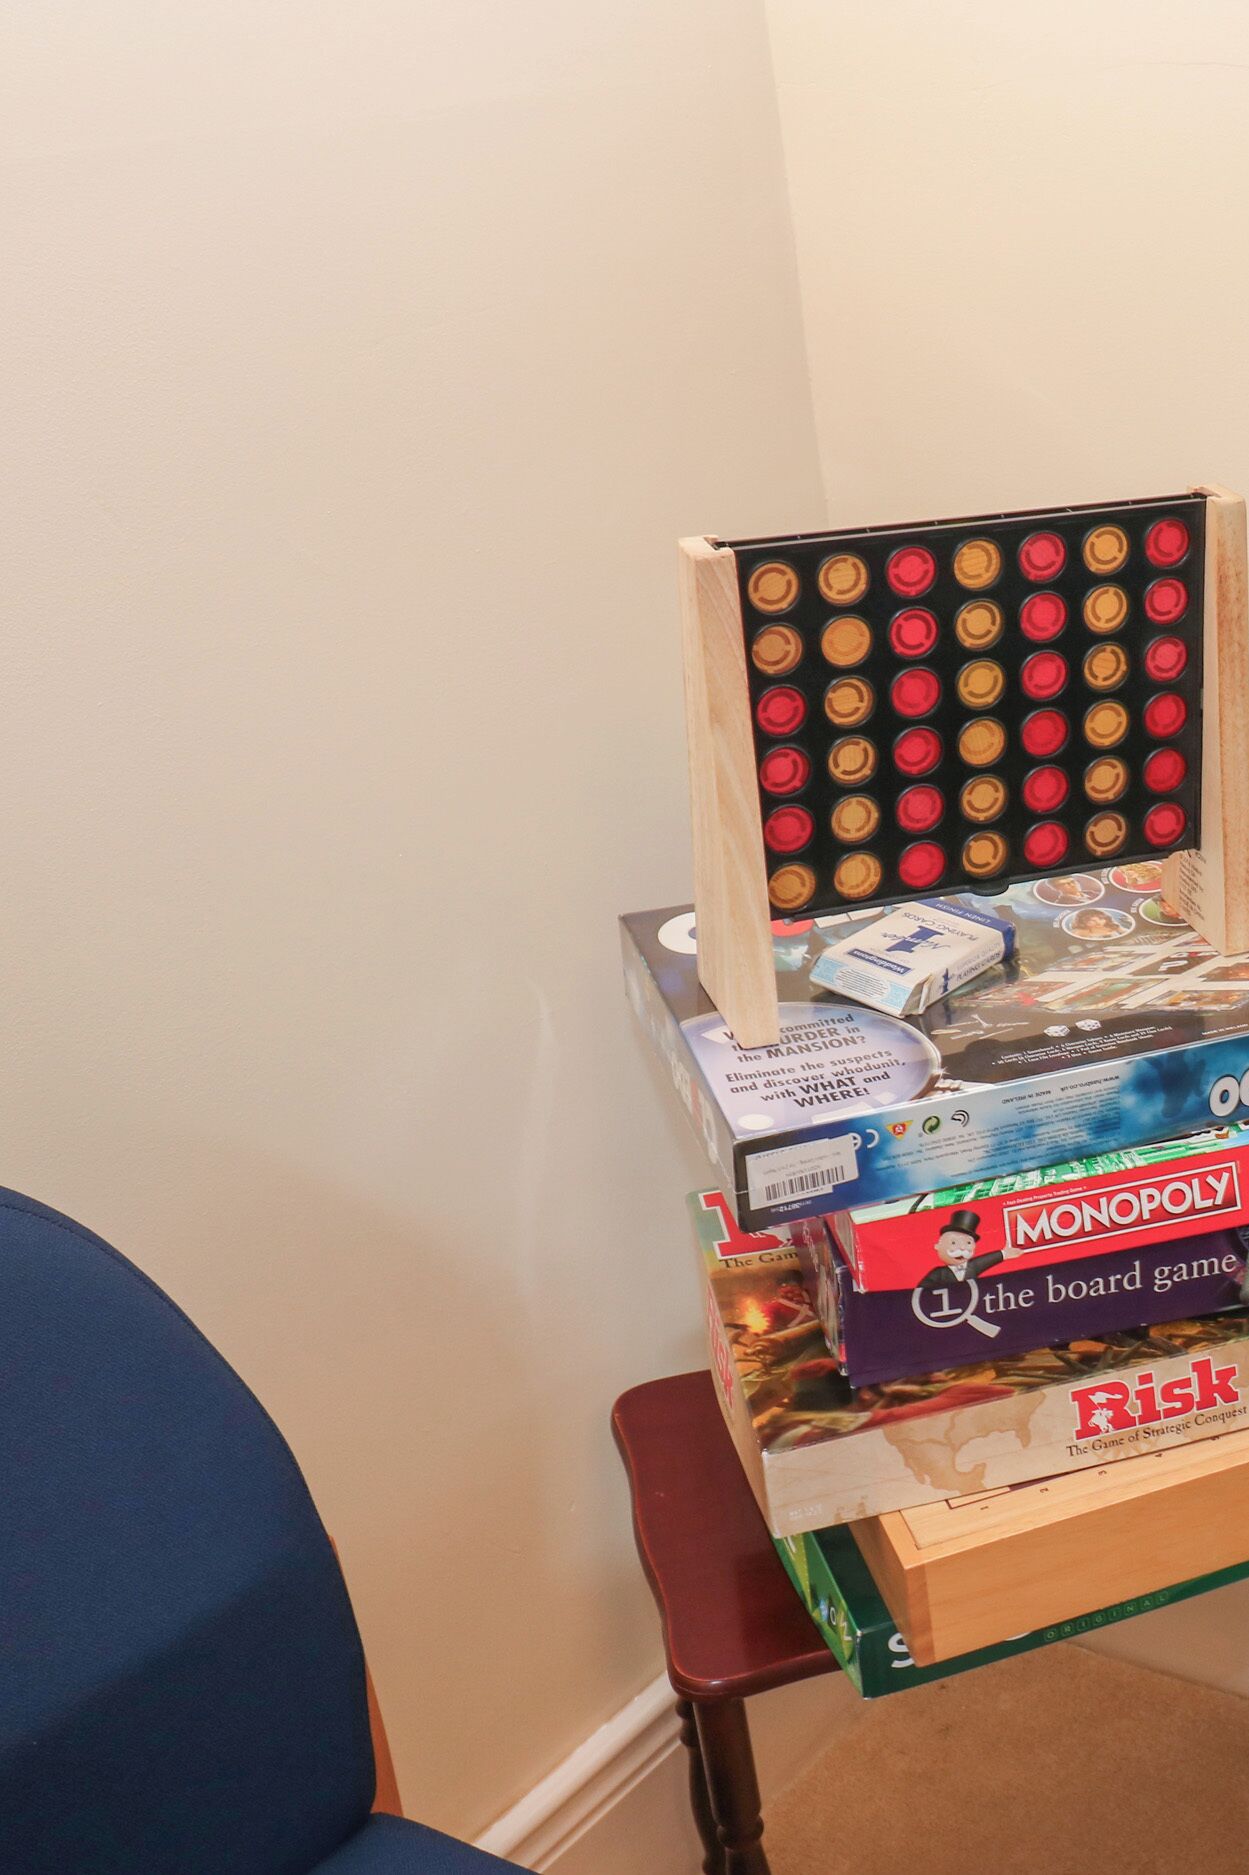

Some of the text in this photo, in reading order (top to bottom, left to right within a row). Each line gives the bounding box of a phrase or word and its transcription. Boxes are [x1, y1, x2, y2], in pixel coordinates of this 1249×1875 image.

[903, 911, 980, 942] PLAYING CARDS
[853, 949, 905, 975] Waddingtons
[779, 1013, 855, 1033] committed
[779, 1025, 861, 1045] URDER in
[736, 1052, 763, 1064] the
[766, 1035, 867, 1059] MANSION?
[725, 1049, 893, 1083] Eliminate the suspects
[730, 1082, 758, 1094] and
[763, 1072, 826, 1091] discover
[760, 1071, 892, 1102] with WHAT and
[793, 1086, 871, 1108] WHERE!
[1016, 1171, 1231, 1246] MONOPOLY
[719, 1251, 798, 1269] The Gam
[983, 1284, 1035, 1314] the
[1047, 1260, 1142, 1303] board
[1153, 1252, 1238, 1293] game
[1070, 1356, 1241, 1441] Risk
[1066, 1405, 1248, 1457] The Game of Strategic Conquest
